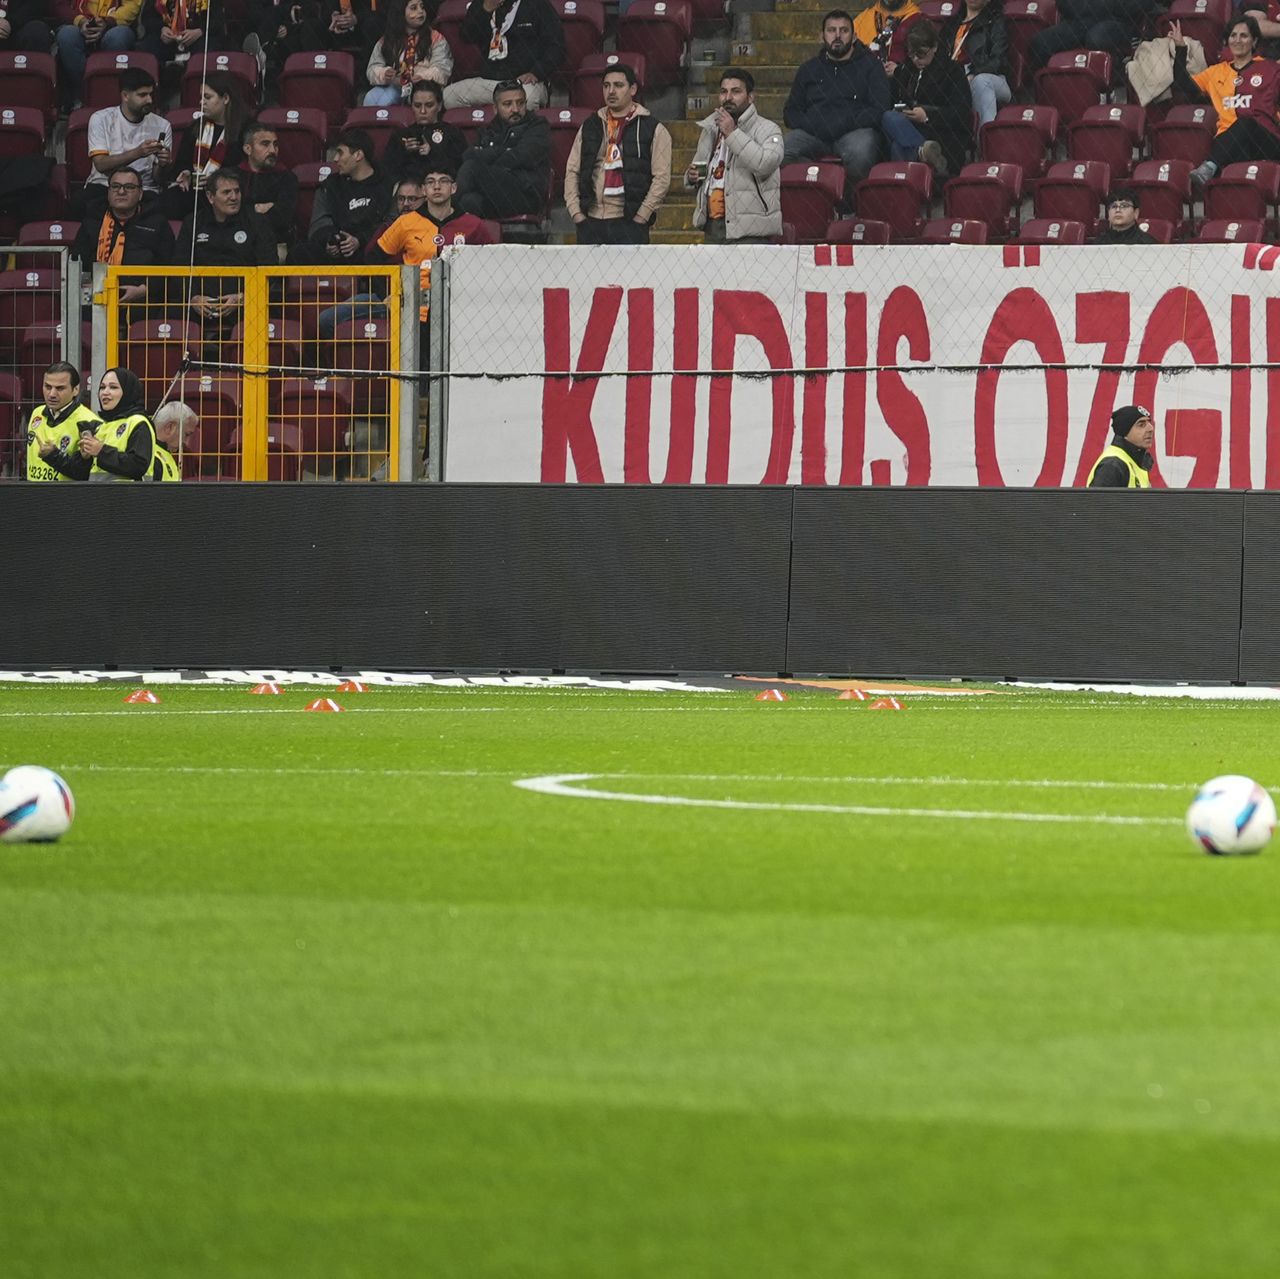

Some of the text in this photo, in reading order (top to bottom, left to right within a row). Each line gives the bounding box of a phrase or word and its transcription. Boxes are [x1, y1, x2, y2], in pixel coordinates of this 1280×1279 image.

[738, 45, 748, 56] 12
[1222, 94, 1253, 110] SIXT
[541, 245, 930, 485] KUDÜS
